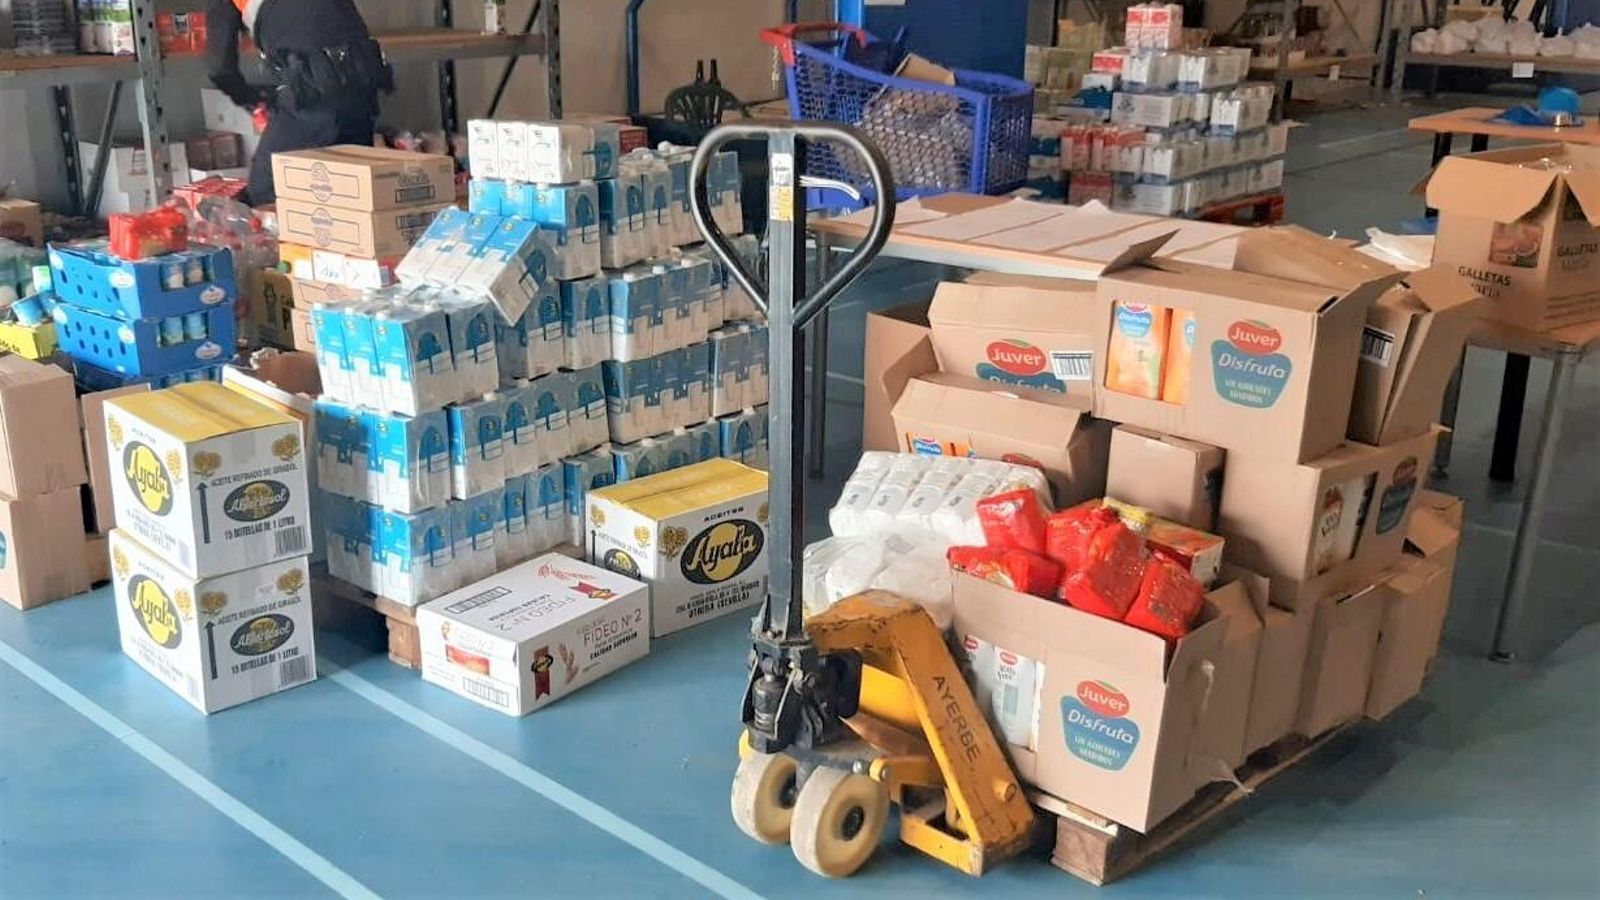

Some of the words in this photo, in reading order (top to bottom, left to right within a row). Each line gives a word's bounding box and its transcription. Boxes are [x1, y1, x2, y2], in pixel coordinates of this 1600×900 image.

[1458, 265, 1512, 287] GALLETAS
[1231, 327, 1279, 348] Juver
[991, 348, 1042, 366] Juver
[1218, 352, 1287, 380] Disfruta
[703, 505, 745, 523] ACEITES
[583, 619, 619, 647] FIDEO
[634, 607, 643, 624] 2
[1079, 686, 1126, 711] Juver
[932, 676, 981, 763] AYERBE
[1067, 708, 1136, 745] Disfruta
